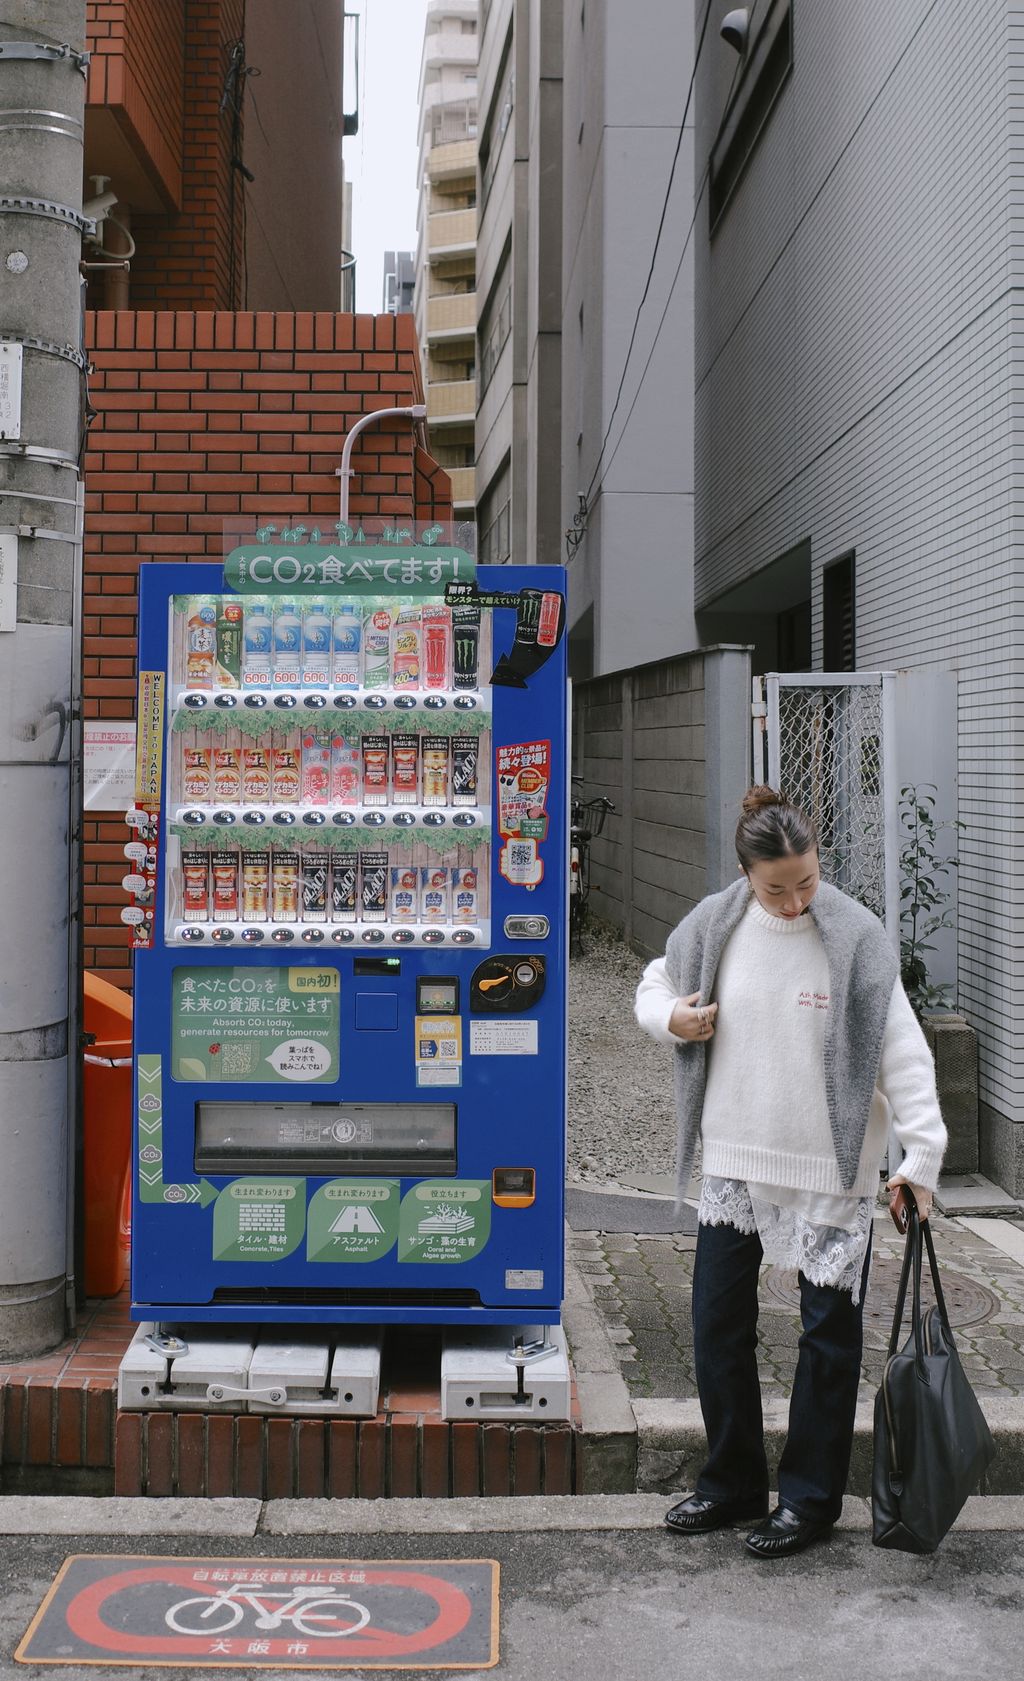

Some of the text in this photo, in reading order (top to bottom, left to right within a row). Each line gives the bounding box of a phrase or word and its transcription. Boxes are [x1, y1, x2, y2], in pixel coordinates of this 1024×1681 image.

[150, 674, 161, 794] WELCOME TO JAPAN
[499, 751, 547, 770] 続々登場!
[453, 752, 477, 790] BLACK
[303, 868, 327, 906] BLACK
[333, 868, 357, 906] BLACK
[362, 868, 386, 905] BLACK
[180, 977, 277, 993] 食べたCO2を
[296, 973, 337, 988] 国内初!
[180, 996, 332, 1013] 未来の資源に使います
[213, 1018, 246, 1026] Absorb
[267, 1018, 295, 1027] today,
[180, 1029, 221, 1037] generate
[271, 1028, 284, 1036] for
[286, 1029, 329, 1037] tomorrow
[288, 1046, 314, 1054] 葉っぱを
[280, 1063, 324, 1071] 読みこんでね!
[235, 1188, 290, 1196] 生まれ変わります
[328, 1189, 385, 1197] 生まれ変わります
[431, 1190, 466, 1198] 役立ちます
[237, 1234, 288, 1245] タイル・建材
[333, 1236, 380, 1245] アスファルト
[408, 1236, 476, 1246] サンゴ・藻の生育
[193, 1569, 367, 1583] 自転車放置禁止区域
[209, 1639, 310, 1655] 大阪市
